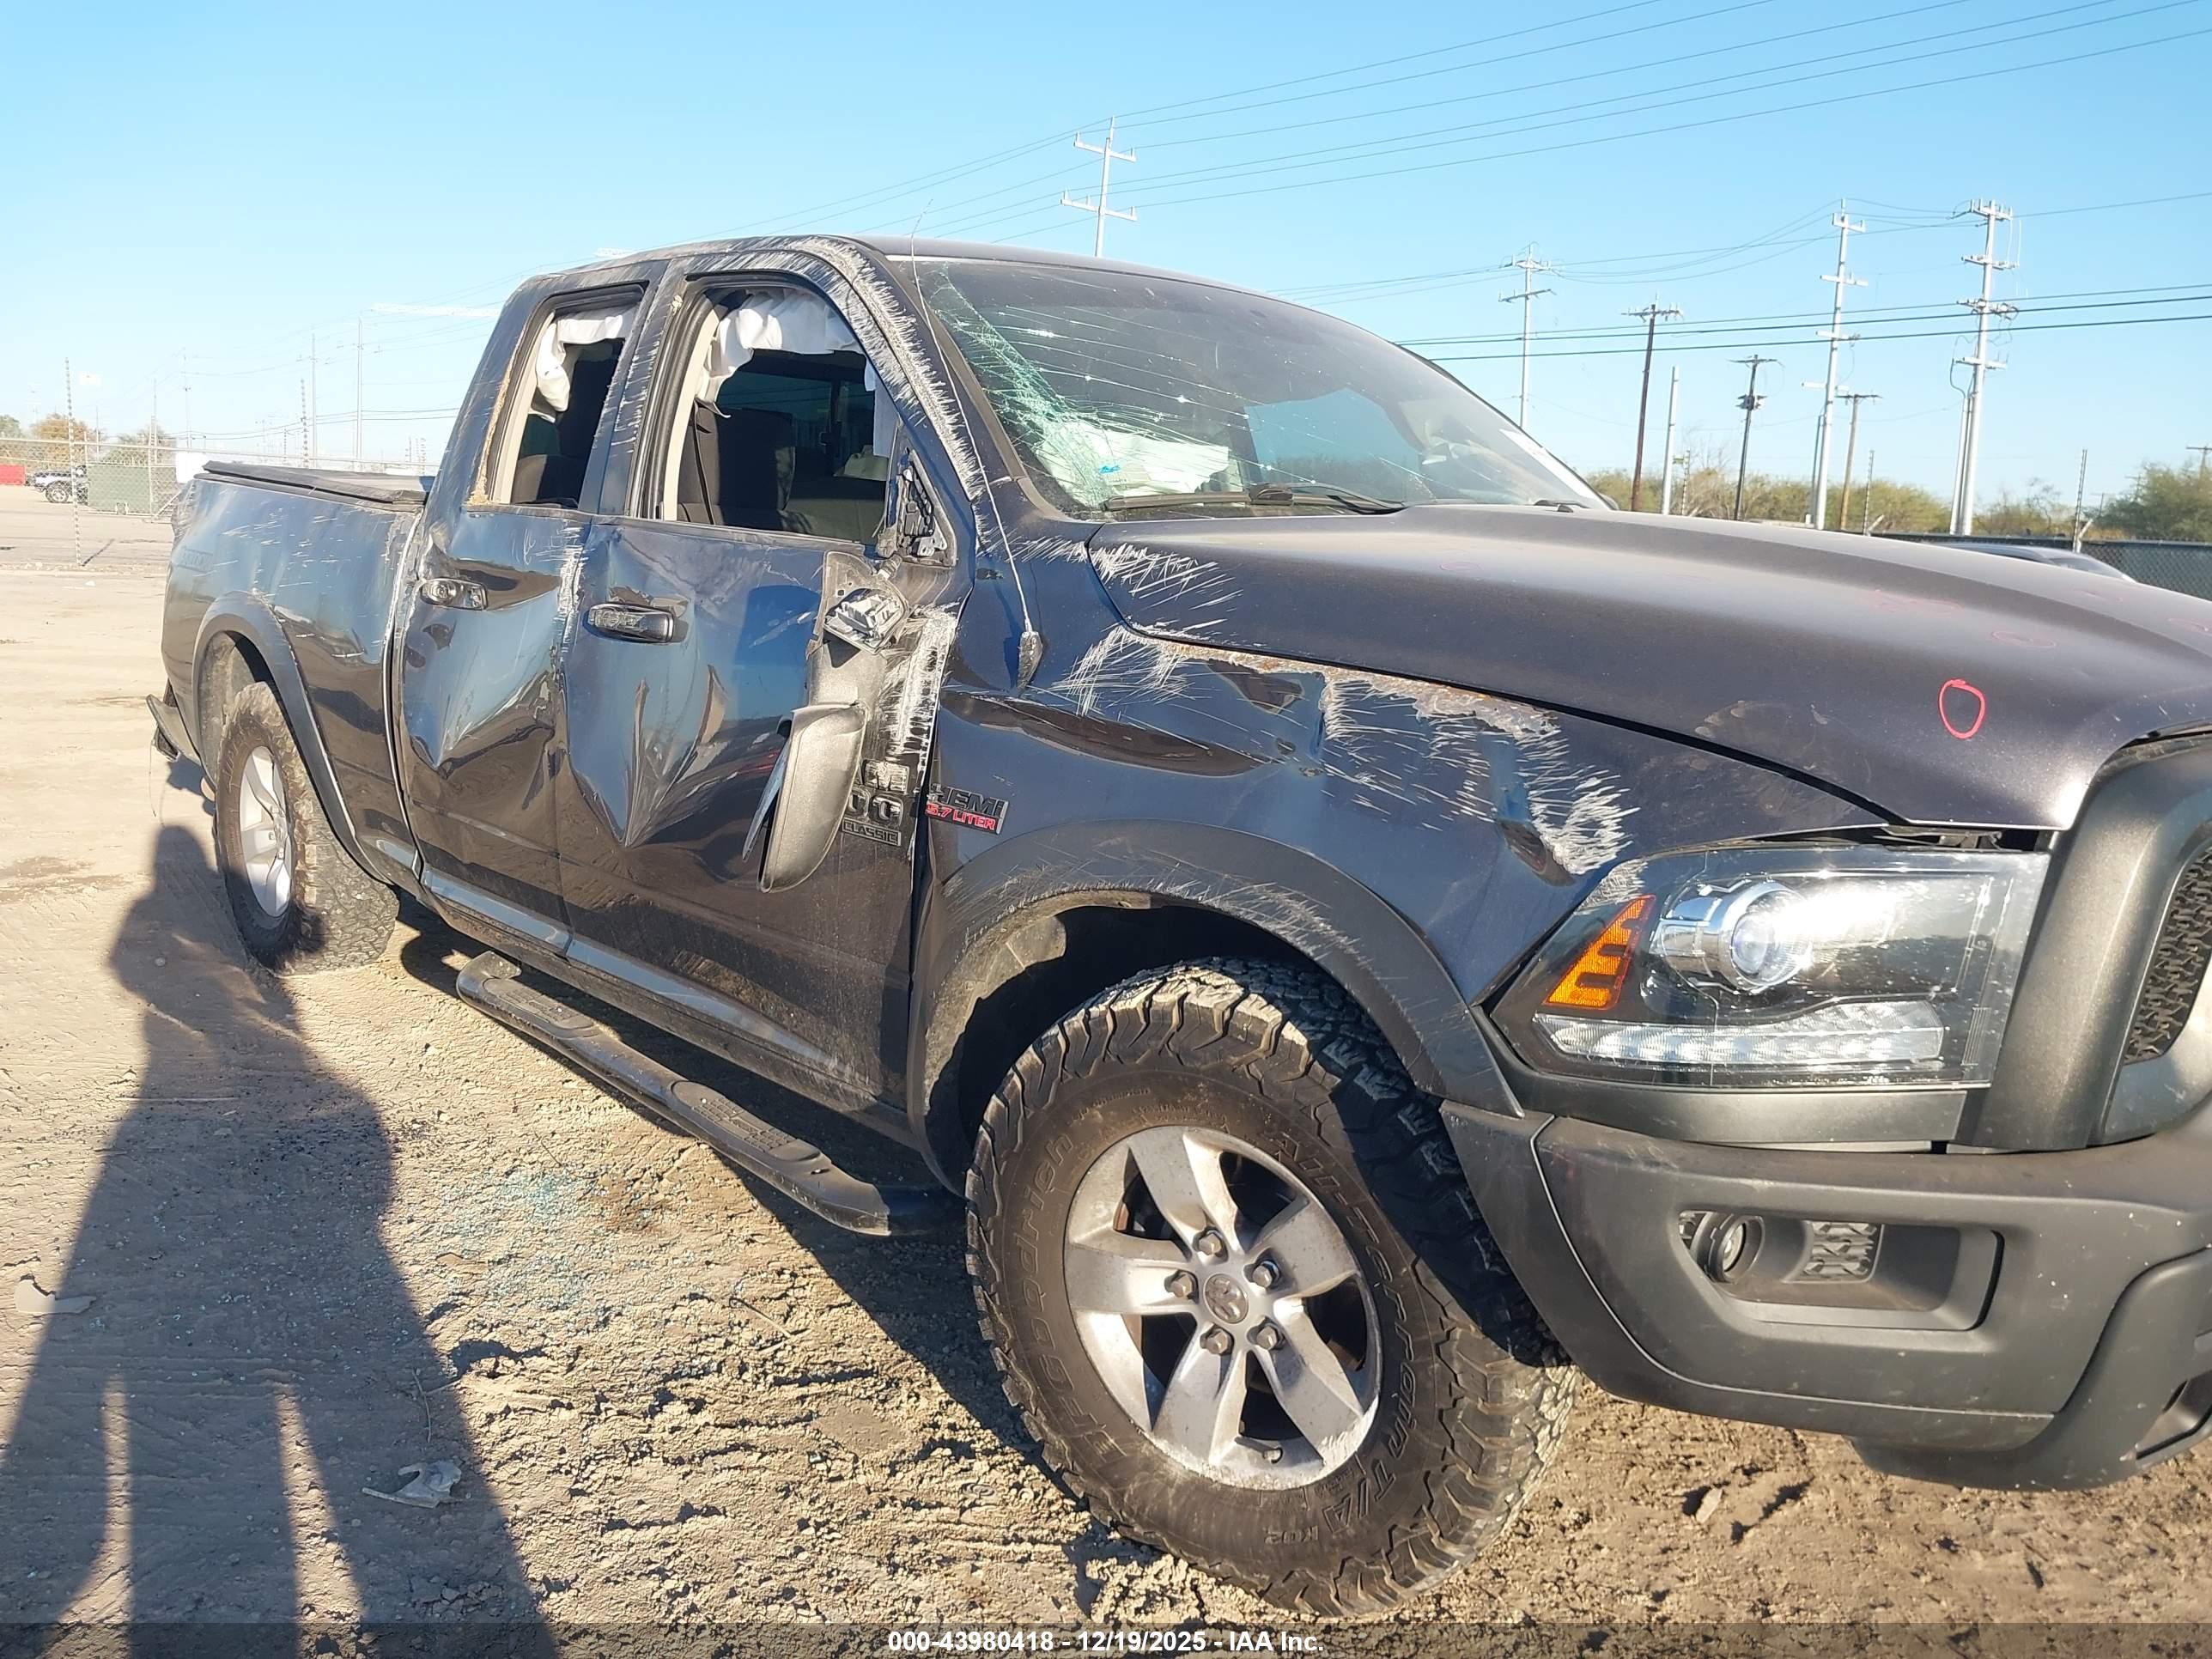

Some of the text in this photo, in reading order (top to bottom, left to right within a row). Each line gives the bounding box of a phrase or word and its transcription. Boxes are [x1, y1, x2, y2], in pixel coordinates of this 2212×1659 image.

[927, 803, 997, 830] 5.7 LITER
[844, 820, 898, 844] CLASSIC
